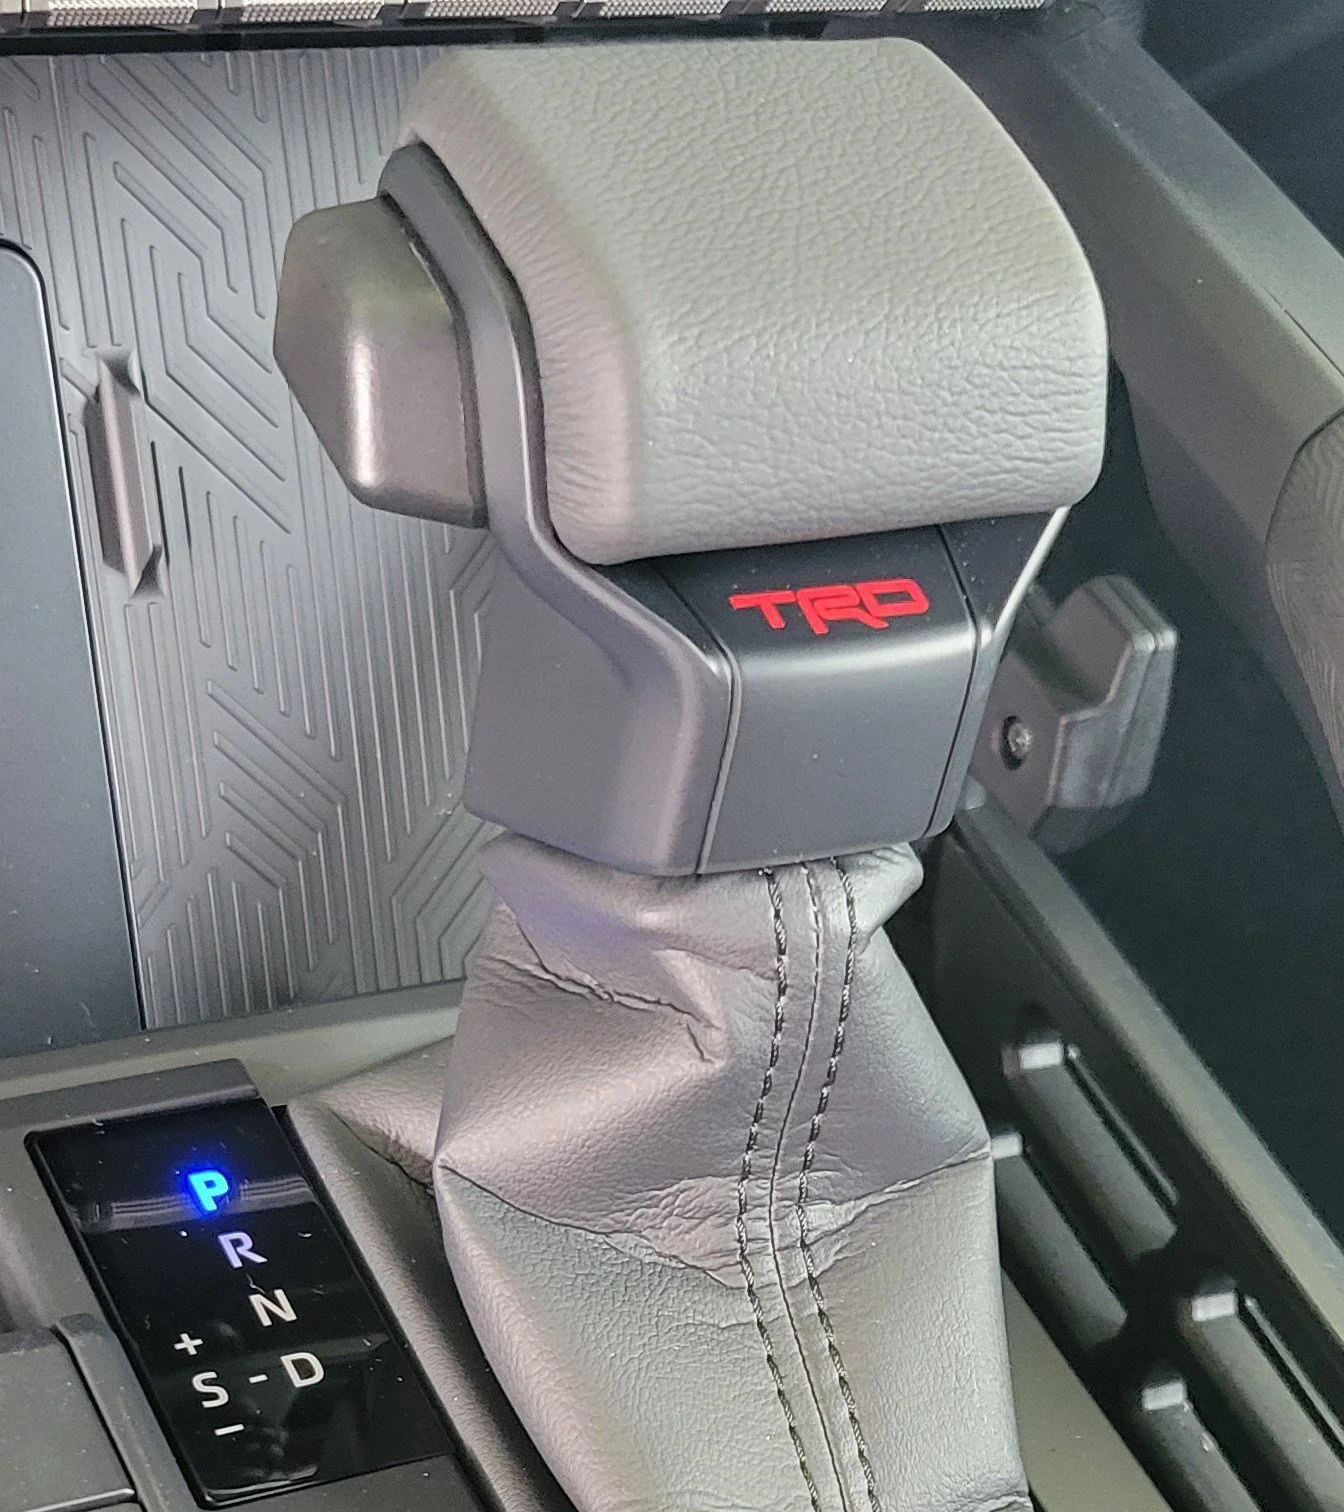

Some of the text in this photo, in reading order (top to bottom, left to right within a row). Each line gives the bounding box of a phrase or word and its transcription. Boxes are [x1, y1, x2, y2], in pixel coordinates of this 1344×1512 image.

[729, 578, 930, 635] TRD
[187, 1169, 229, 1211] P
[217, 1231, 267, 1268] R
[248, 1288, 297, 1327] N
